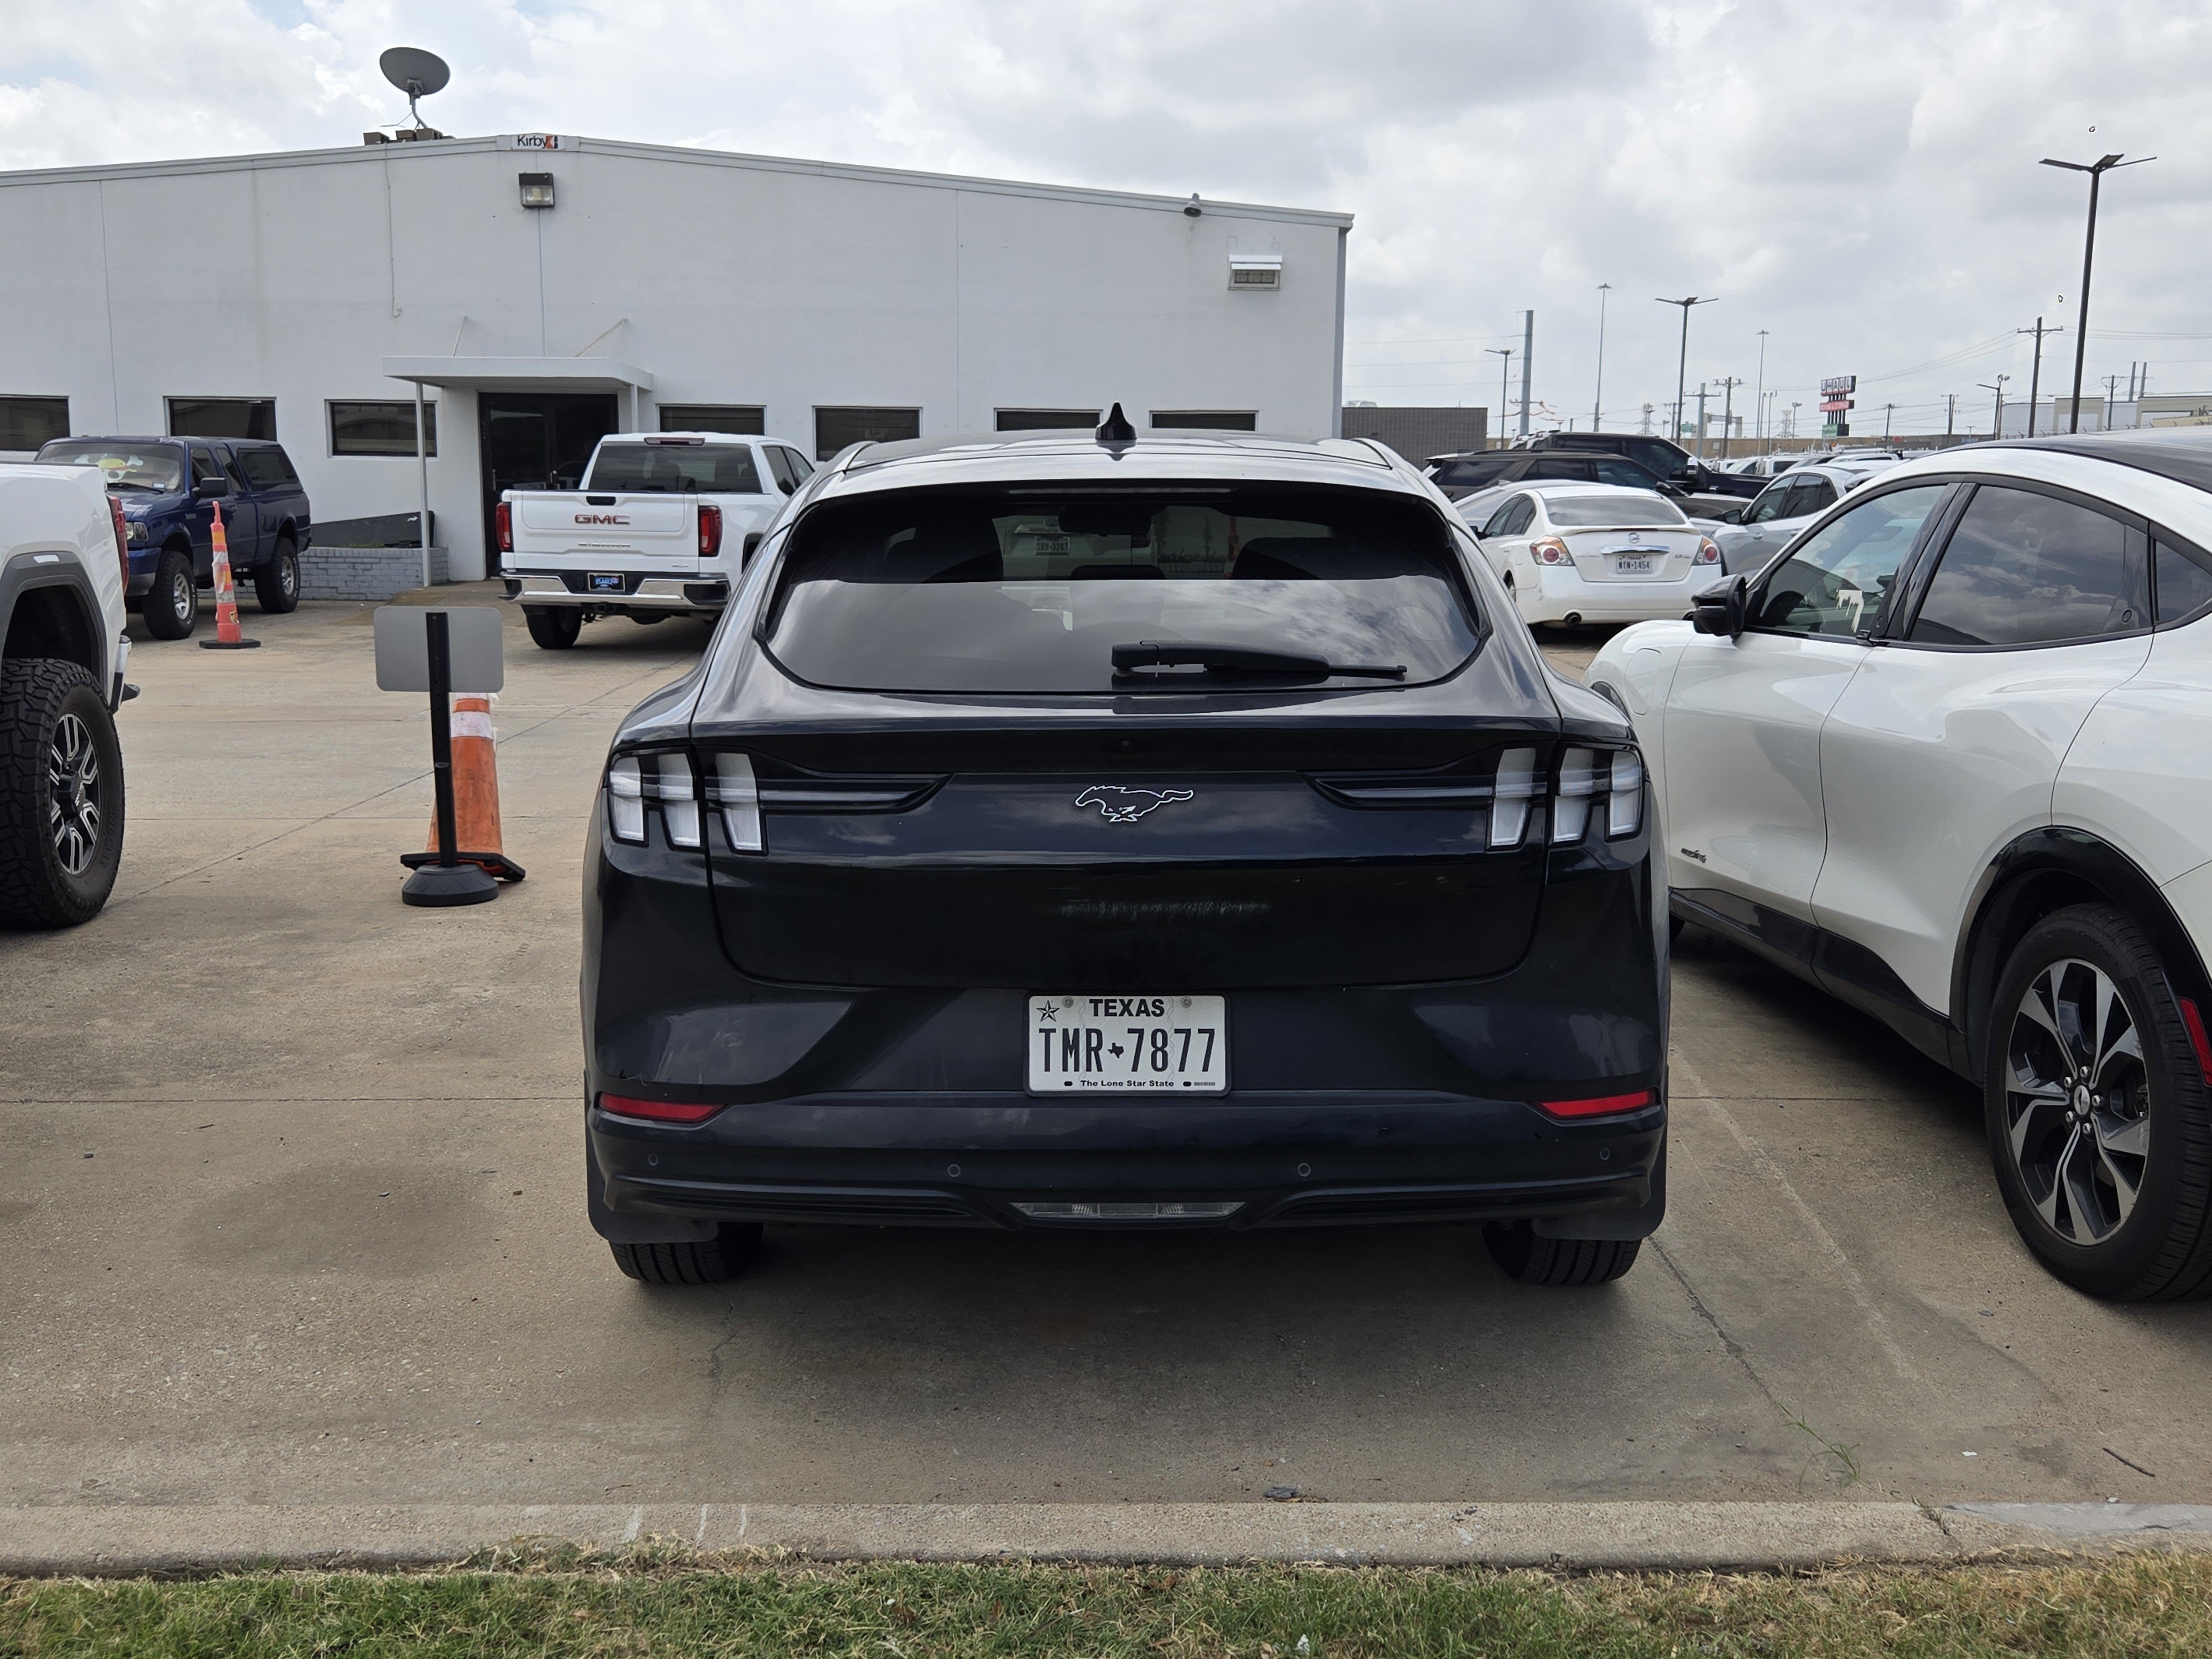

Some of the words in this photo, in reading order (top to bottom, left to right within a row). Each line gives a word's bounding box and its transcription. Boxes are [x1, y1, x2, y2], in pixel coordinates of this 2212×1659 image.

[517, 134, 546, 149] Kirby
[575, 514, 630, 525] GMC
[1089, 999, 1165, 1017] TEXAS
[1127, 1028, 1215, 1072] 7877
